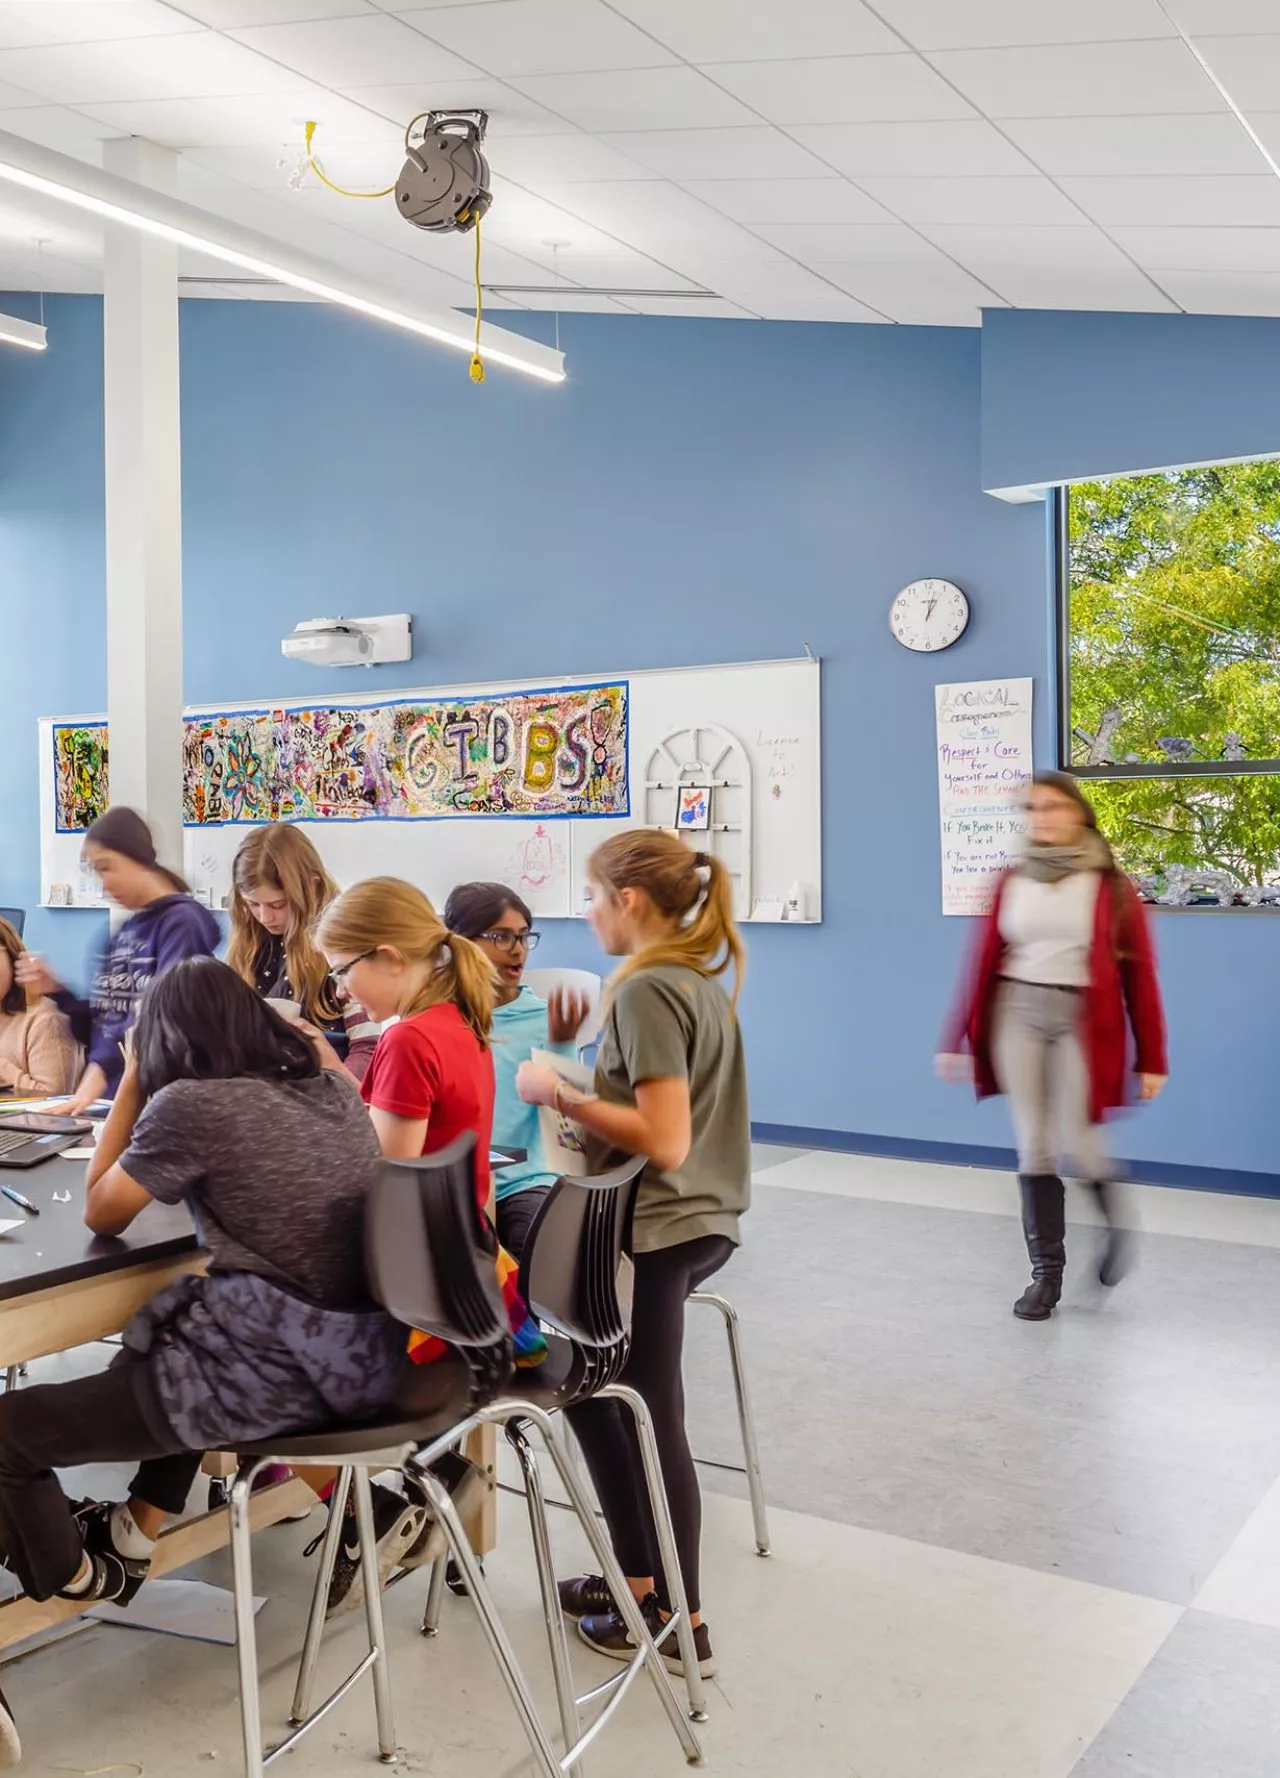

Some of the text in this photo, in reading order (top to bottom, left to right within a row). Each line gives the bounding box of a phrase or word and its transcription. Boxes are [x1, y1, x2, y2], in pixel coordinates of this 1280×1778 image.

[924, 582, 934, 590] 12
[943, 585, 947, 593] 1
[908, 588, 916, 596] 11
[897, 599, 906, 607] 10
[954, 595, 960, 603] 2
[957, 608, 964, 617] 3
[894, 613, 900, 621] 9
[899, 628, 904, 636] 8
[909, 639, 915, 647] 7
[942, 637, 948, 645] 5
[925, 641, 932, 650] 6
[940, 687, 1019, 708] LOGICAL
[940, 744, 980, 765] Respect
[994, 741, 1021, 758] Care
